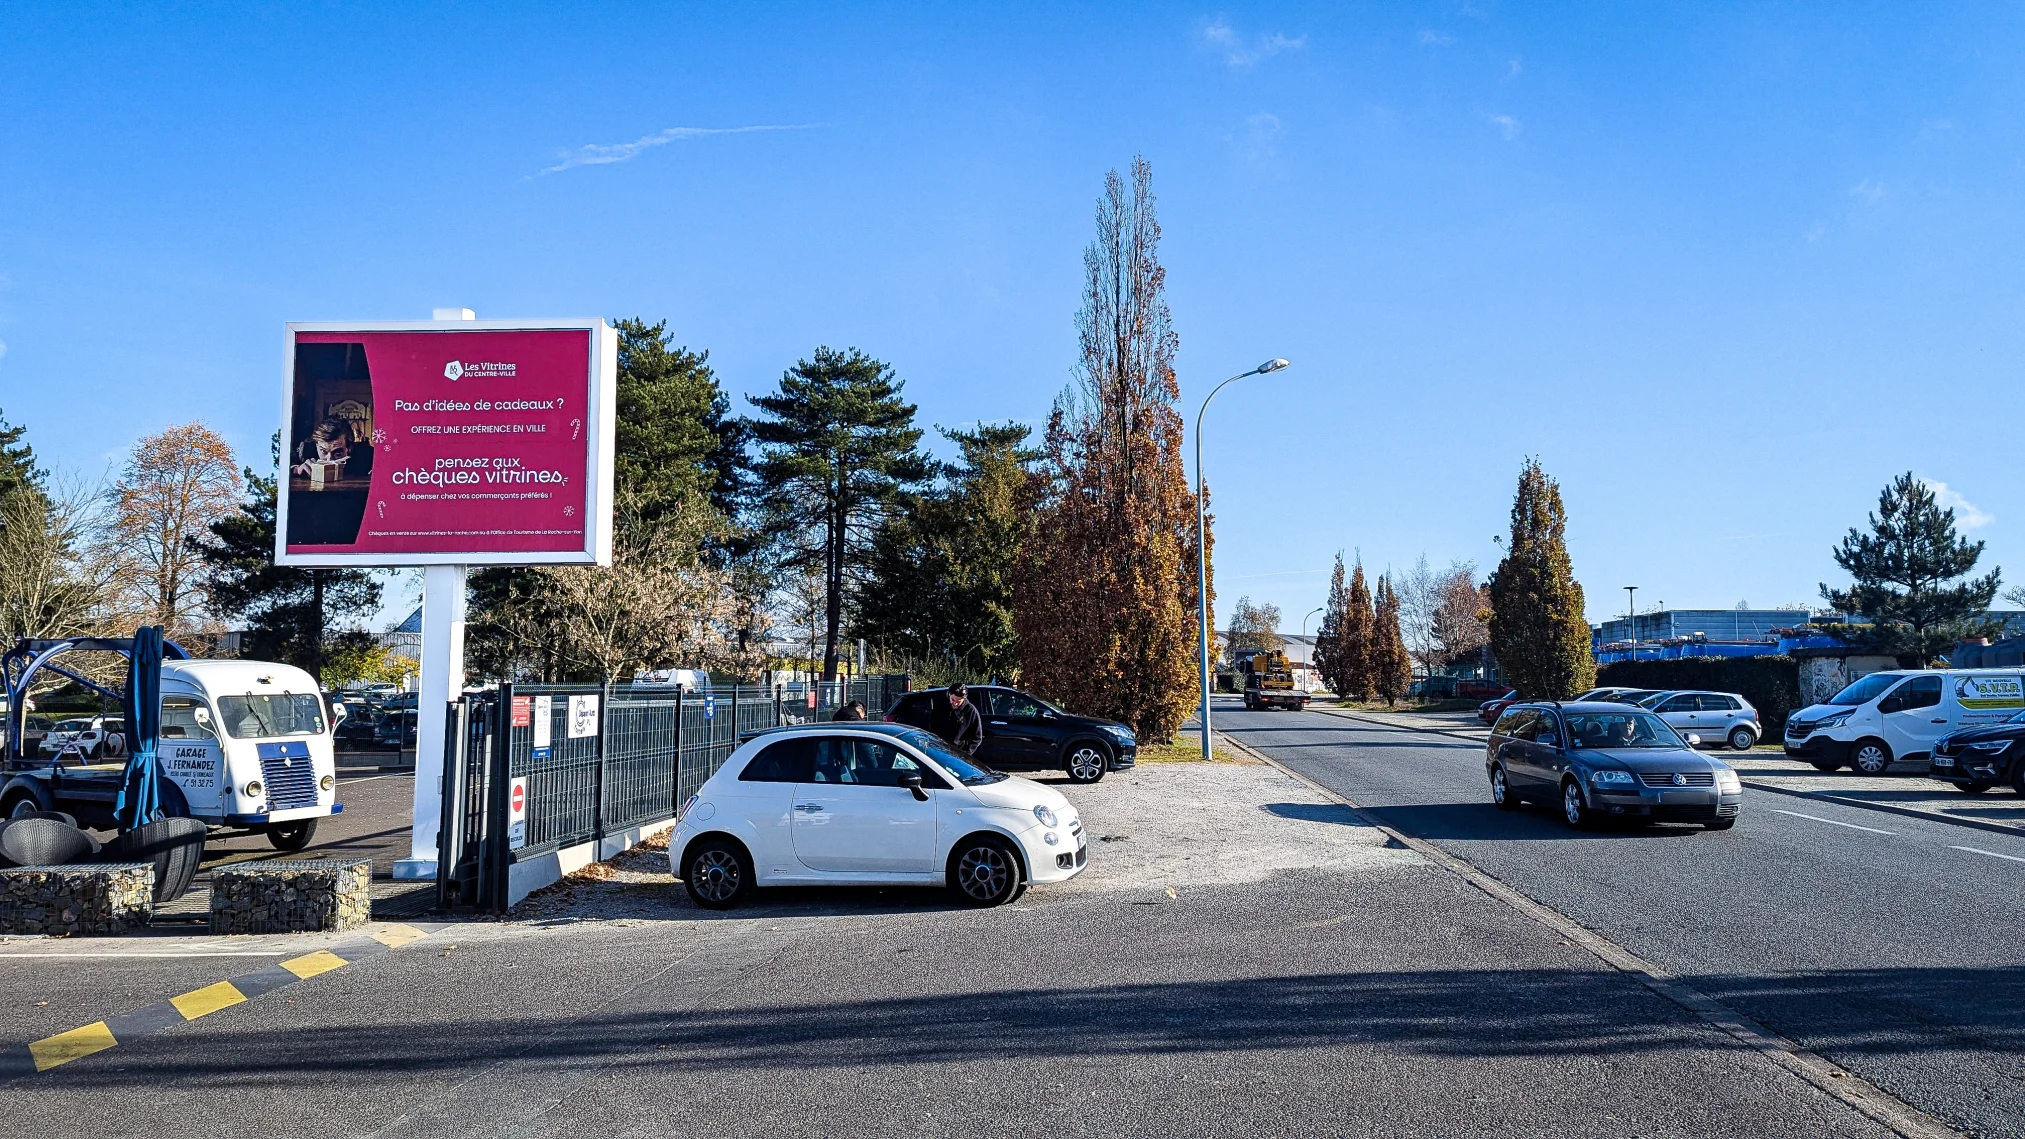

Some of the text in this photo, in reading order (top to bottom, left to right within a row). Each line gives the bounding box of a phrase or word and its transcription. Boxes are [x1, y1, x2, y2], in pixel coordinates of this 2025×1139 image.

[465, 363, 479, 371] Les
[480, 362, 516, 371] Vitrines
[395, 397, 564, 411] Pas d'idées de cadeaux ?
[411, 423, 546, 434] OFFREZ UNE EXPÉRIENCE EN VILLE
[435, 457, 521, 471] pensez aux
[392, 467, 562, 488] chèques vitrines
[400, 492, 406, 500] à
[407, 493, 440, 502] dépenser
[472, 493, 520, 502] commerçants
[521, 491, 549, 501] préférés
[176, 748, 207, 758] GARAGE
